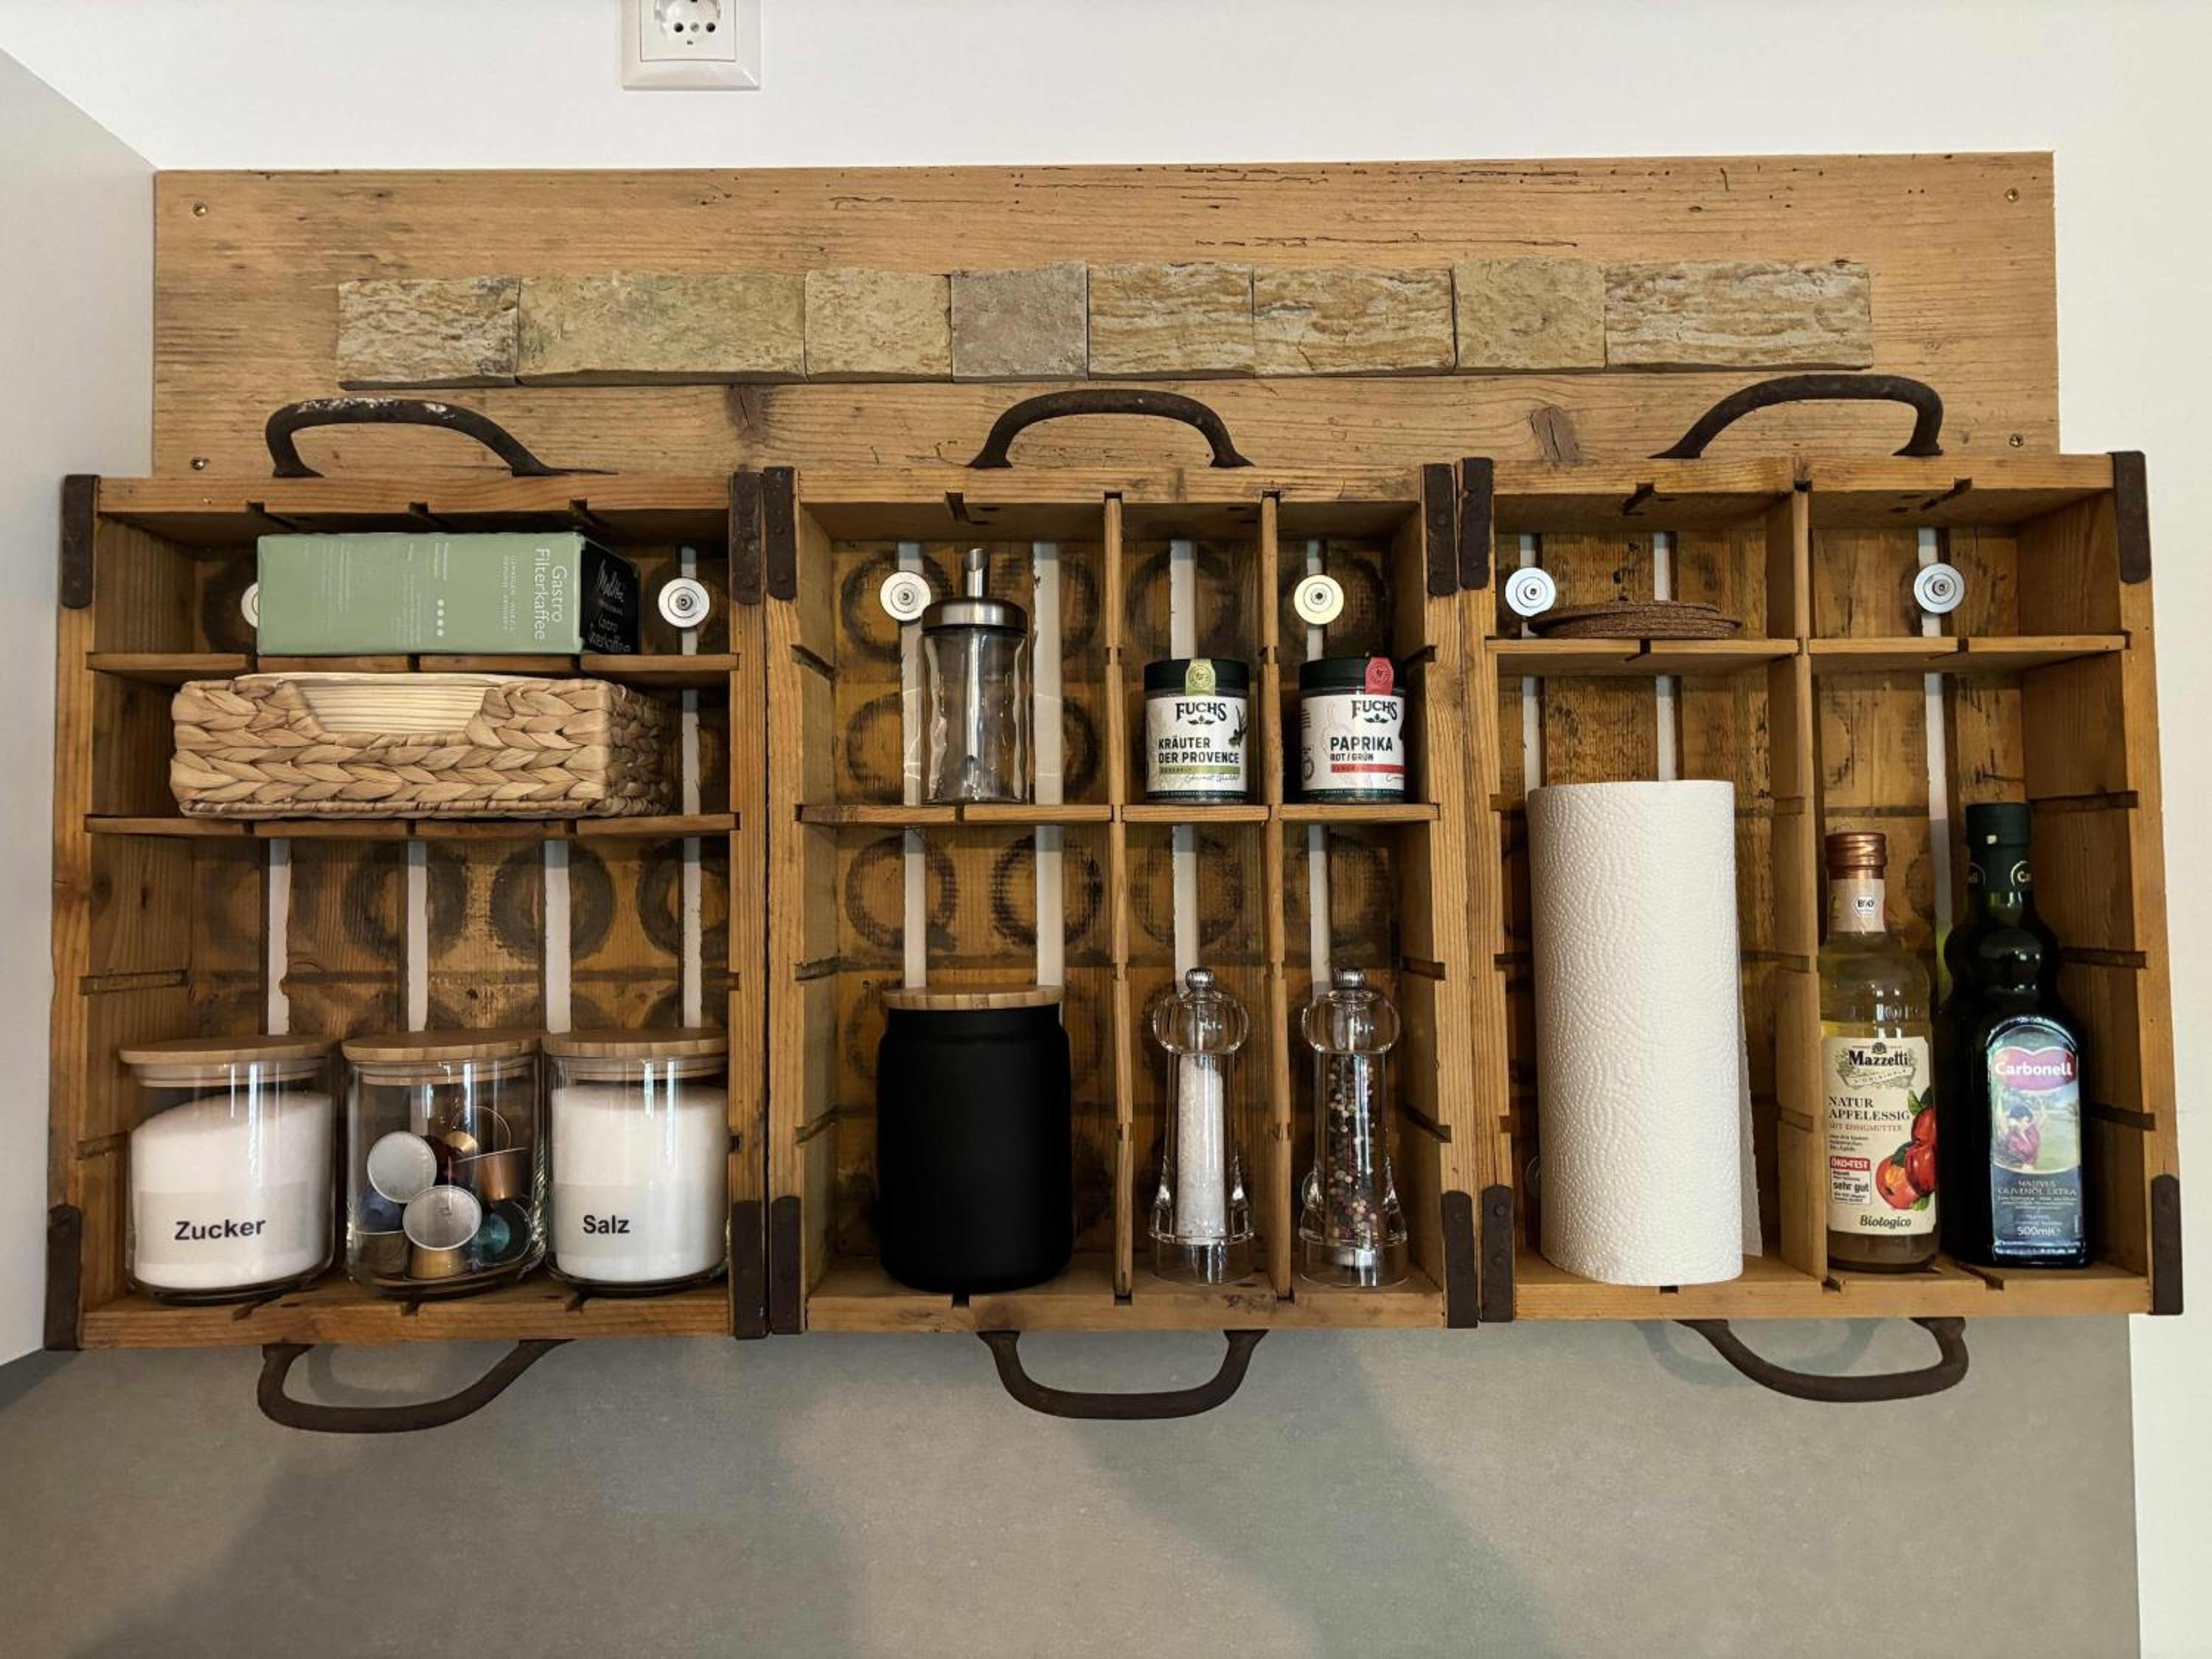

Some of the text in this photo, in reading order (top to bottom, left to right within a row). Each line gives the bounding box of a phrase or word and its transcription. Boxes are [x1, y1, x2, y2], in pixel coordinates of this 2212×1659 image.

[534, 549, 551, 640] Filterkaffee
[552, 566, 567, 623] Gastro
[1175, 703, 1227, 722] FUCHS
[1351, 700, 1397, 720] FUCHS
[1158, 735, 1210, 749] KRÄUTER
[1331, 737, 1393, 751] PAPRIKA
[1158, 751, 1239, 764] DER PROVENCE
[1848, 1049, 1908, 1066] Mazzetti
[1994, 1062, 2073, 1077] Carbonell
[1829, 1096, 1874, 1108] NATUR
[1829, 1109, 1910, 1121] APFELESSIG
[1833, 1182, 1869, 1193] sehr gut
[175, 1219, 266, 1240] Zucker
[583, 1214, 630, 1234] Salz
[1860, 1215, 1911, 1229] Biologico
